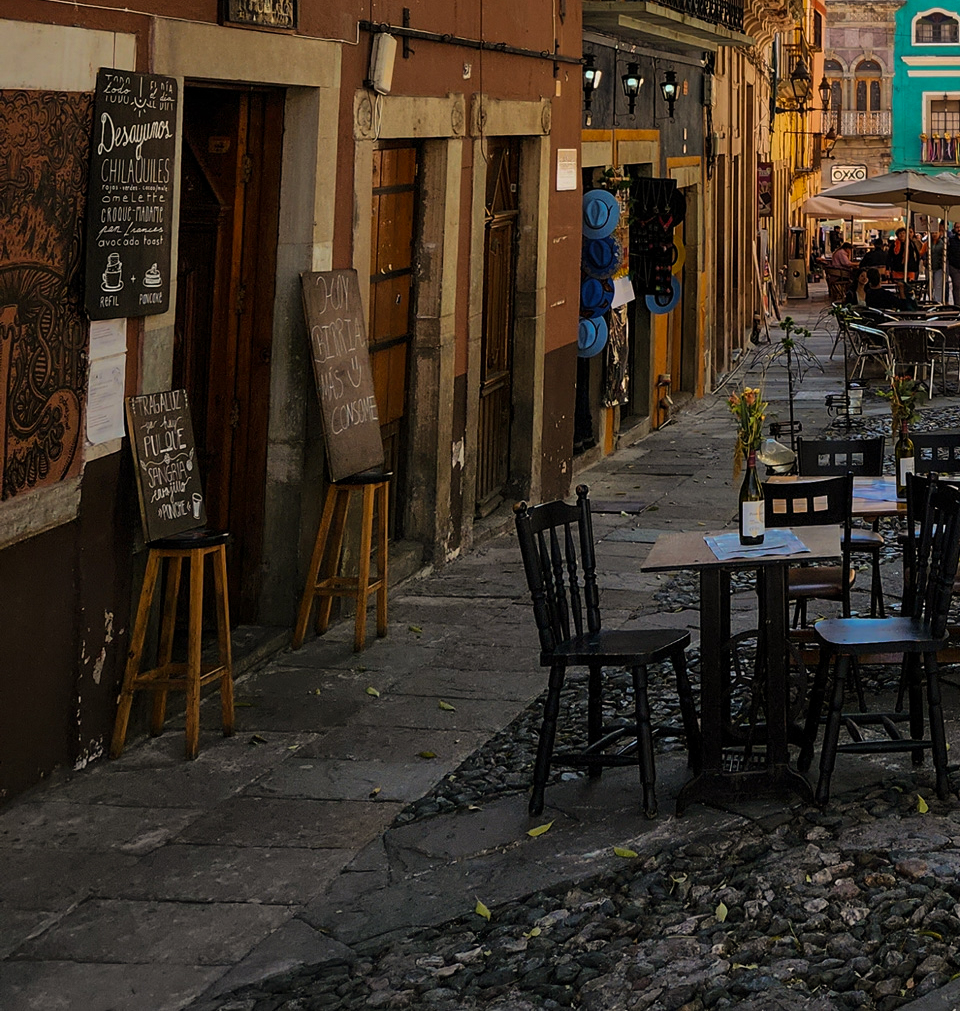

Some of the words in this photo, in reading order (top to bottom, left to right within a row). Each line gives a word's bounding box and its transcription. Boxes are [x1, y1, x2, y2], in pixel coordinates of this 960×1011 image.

[97, 112, 173, 161] Desayunos
[101, 158, 170, 184] CHILAQUILES
[833, 168, 865, 181] OXXO
[95, 225, 123, 241] pan
[97, 235, 140, 248] avocado
[143, 234, 164, 246] toast
[311, 317, 367, 363] BIRRIA
[135, 389, 182, 416] TRAGALUZ
[143, 428, 187, 458] PULQUE
[147, 459, 188, 489] SANGRÍA
